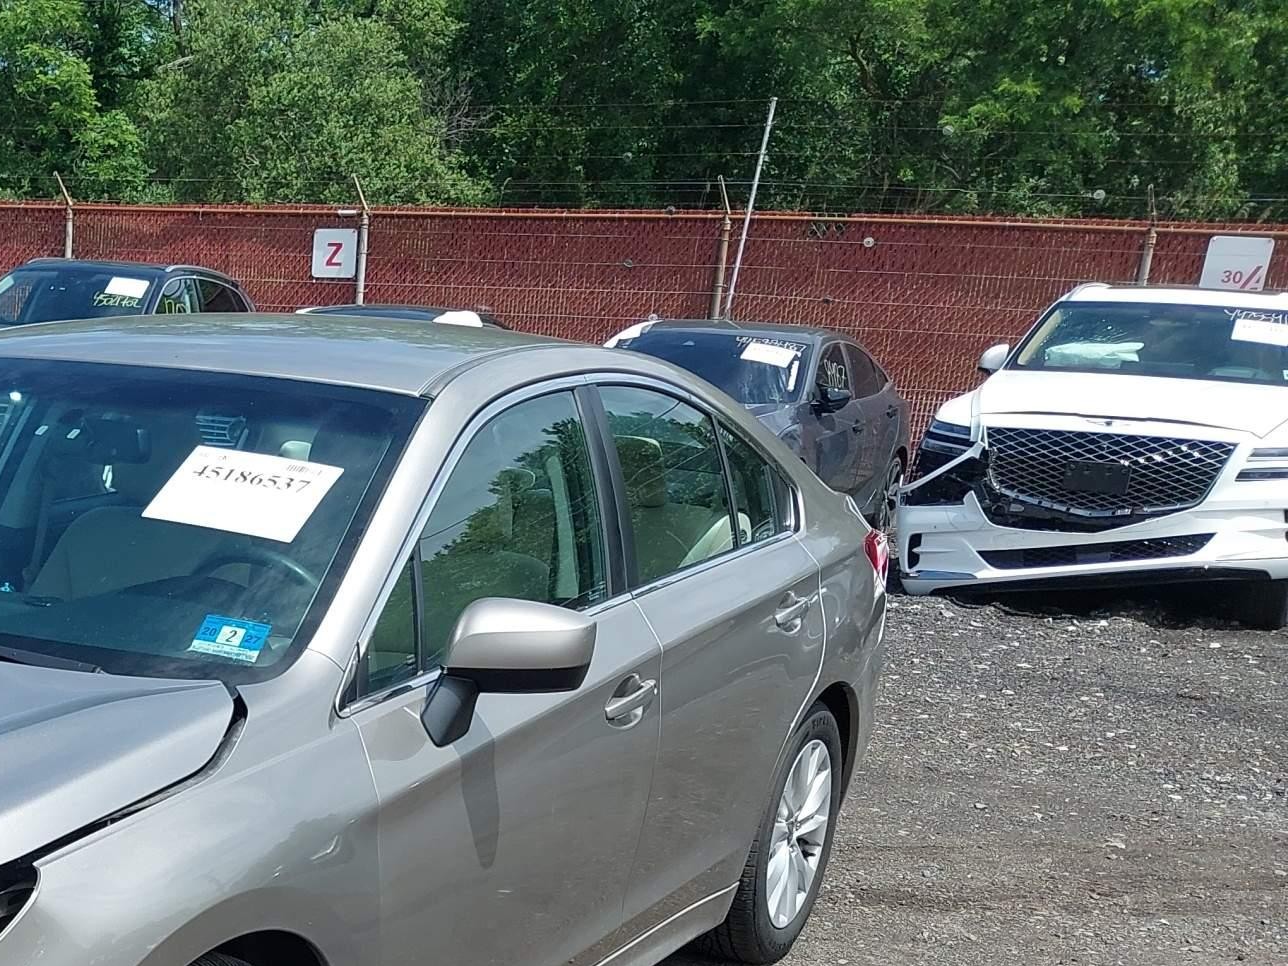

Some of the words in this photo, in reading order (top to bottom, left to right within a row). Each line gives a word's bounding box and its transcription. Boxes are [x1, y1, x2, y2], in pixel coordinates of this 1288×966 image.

[325, 242, 343, 266] Z
[192, 464, 311, 493] 45186537
[201, 626, 217, 637] 20
[224, 629, 238, 643] 2
[244, 634, 262, 645] 27
